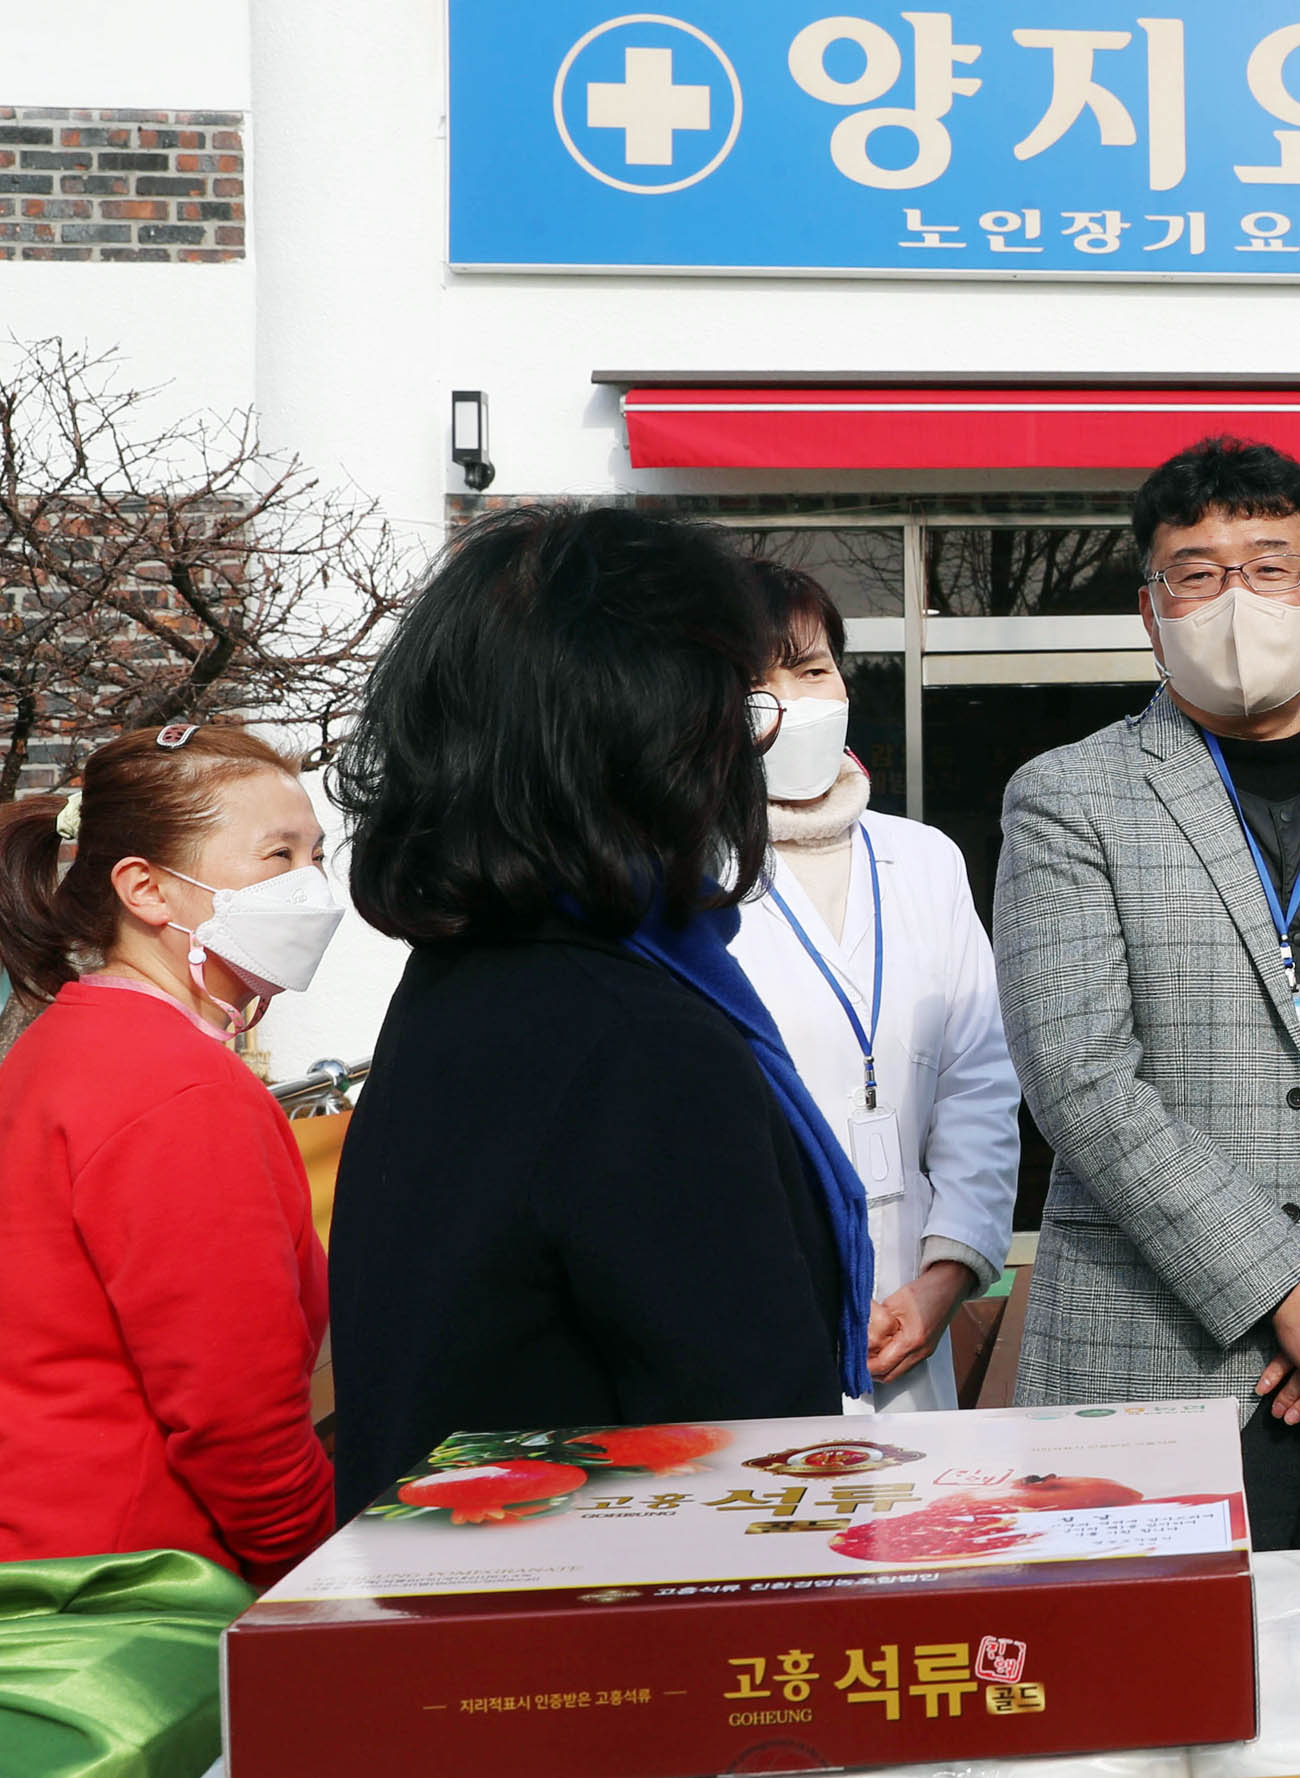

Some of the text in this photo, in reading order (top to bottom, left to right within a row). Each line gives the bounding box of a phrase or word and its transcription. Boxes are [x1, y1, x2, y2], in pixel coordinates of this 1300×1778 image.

[898, 208, 1206, 256] 노인장기
[576, 1482, 923, 1517] 고흥 석류
[653, 1583, 742, 1597] 고흥석류
[723, 1643, 978, 1720] 고흥 석류
[460, 1688, 652, 1714] 지리적표시 인증받은 고흥석류
[991, 1685, 1042, 1712] 골드
[728, 1709, 814, 1727] GOHEUNG
